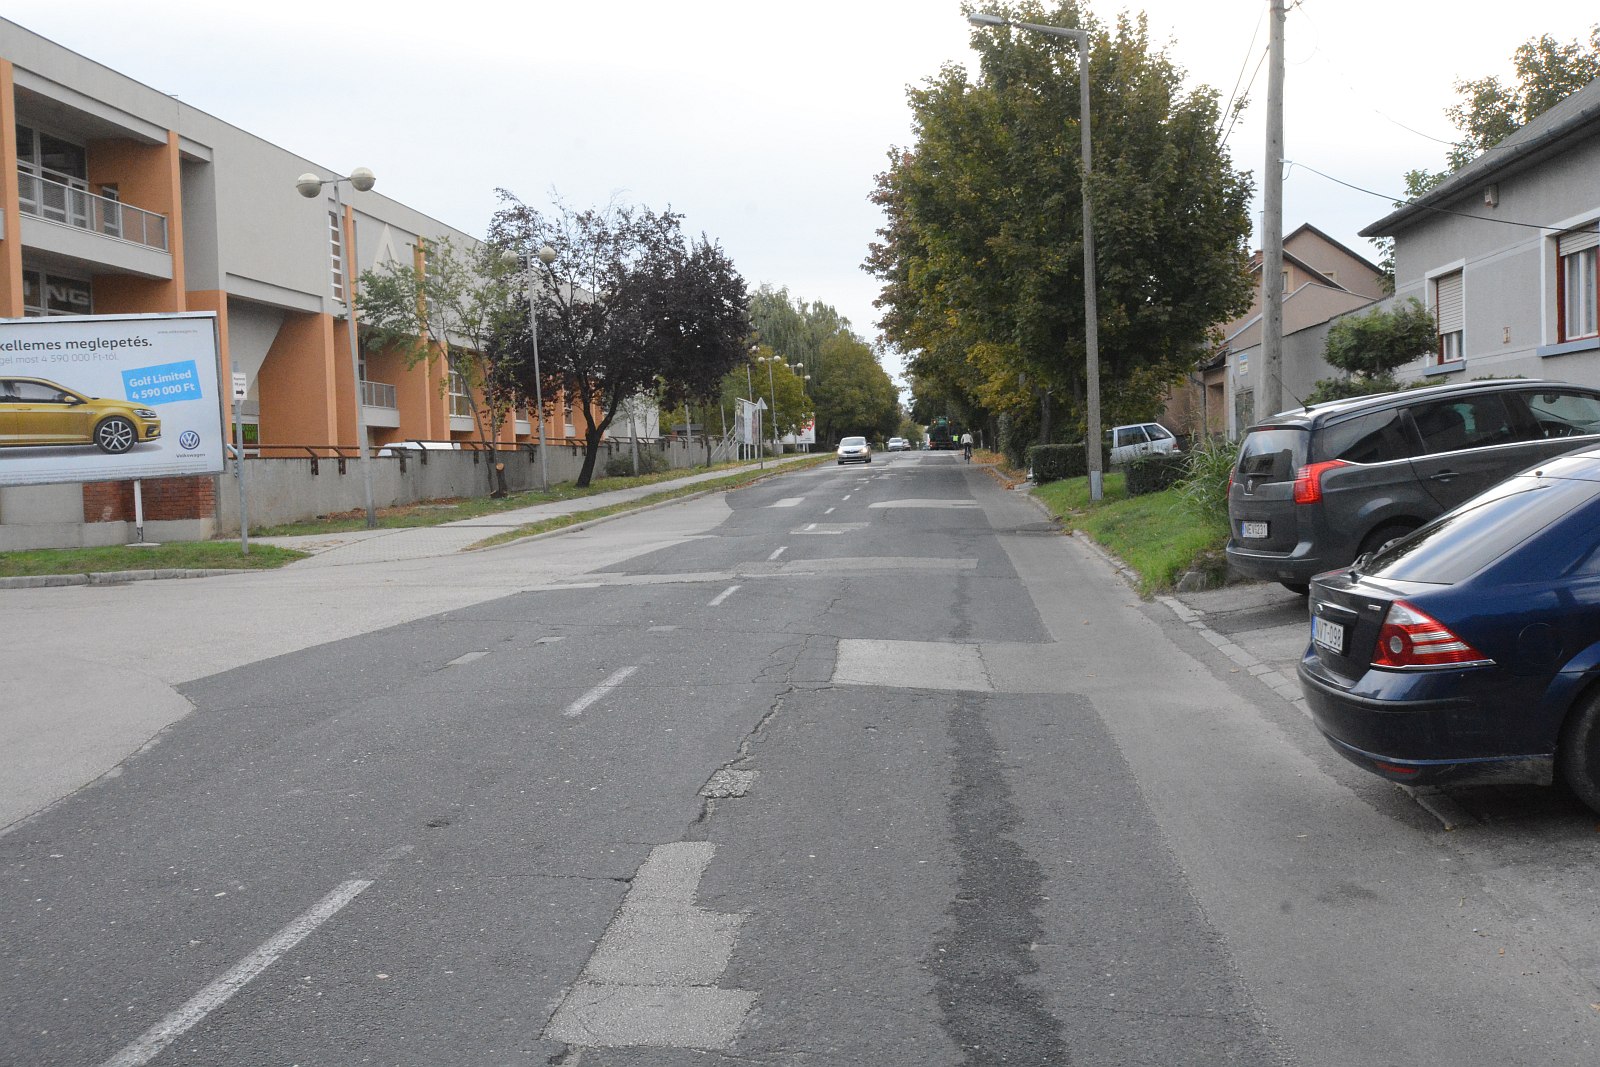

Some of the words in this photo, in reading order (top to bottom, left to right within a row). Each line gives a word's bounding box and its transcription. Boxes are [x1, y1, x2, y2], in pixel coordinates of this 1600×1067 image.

[66, 336, 152, 351] meglepetés.
[16, 356, 39, 364] most
[51, 353, 69, 363] 590
[72, 353, 90, 362] 000
[129, 375, 152, 388] Golf
[153, 369, 192, 384] Limited
[132, 391, 139, 400] 4
[141, 387, 160, 399] 590
[162, 384, 182, 395] 000
[184, 382, 195, 392] Ft
